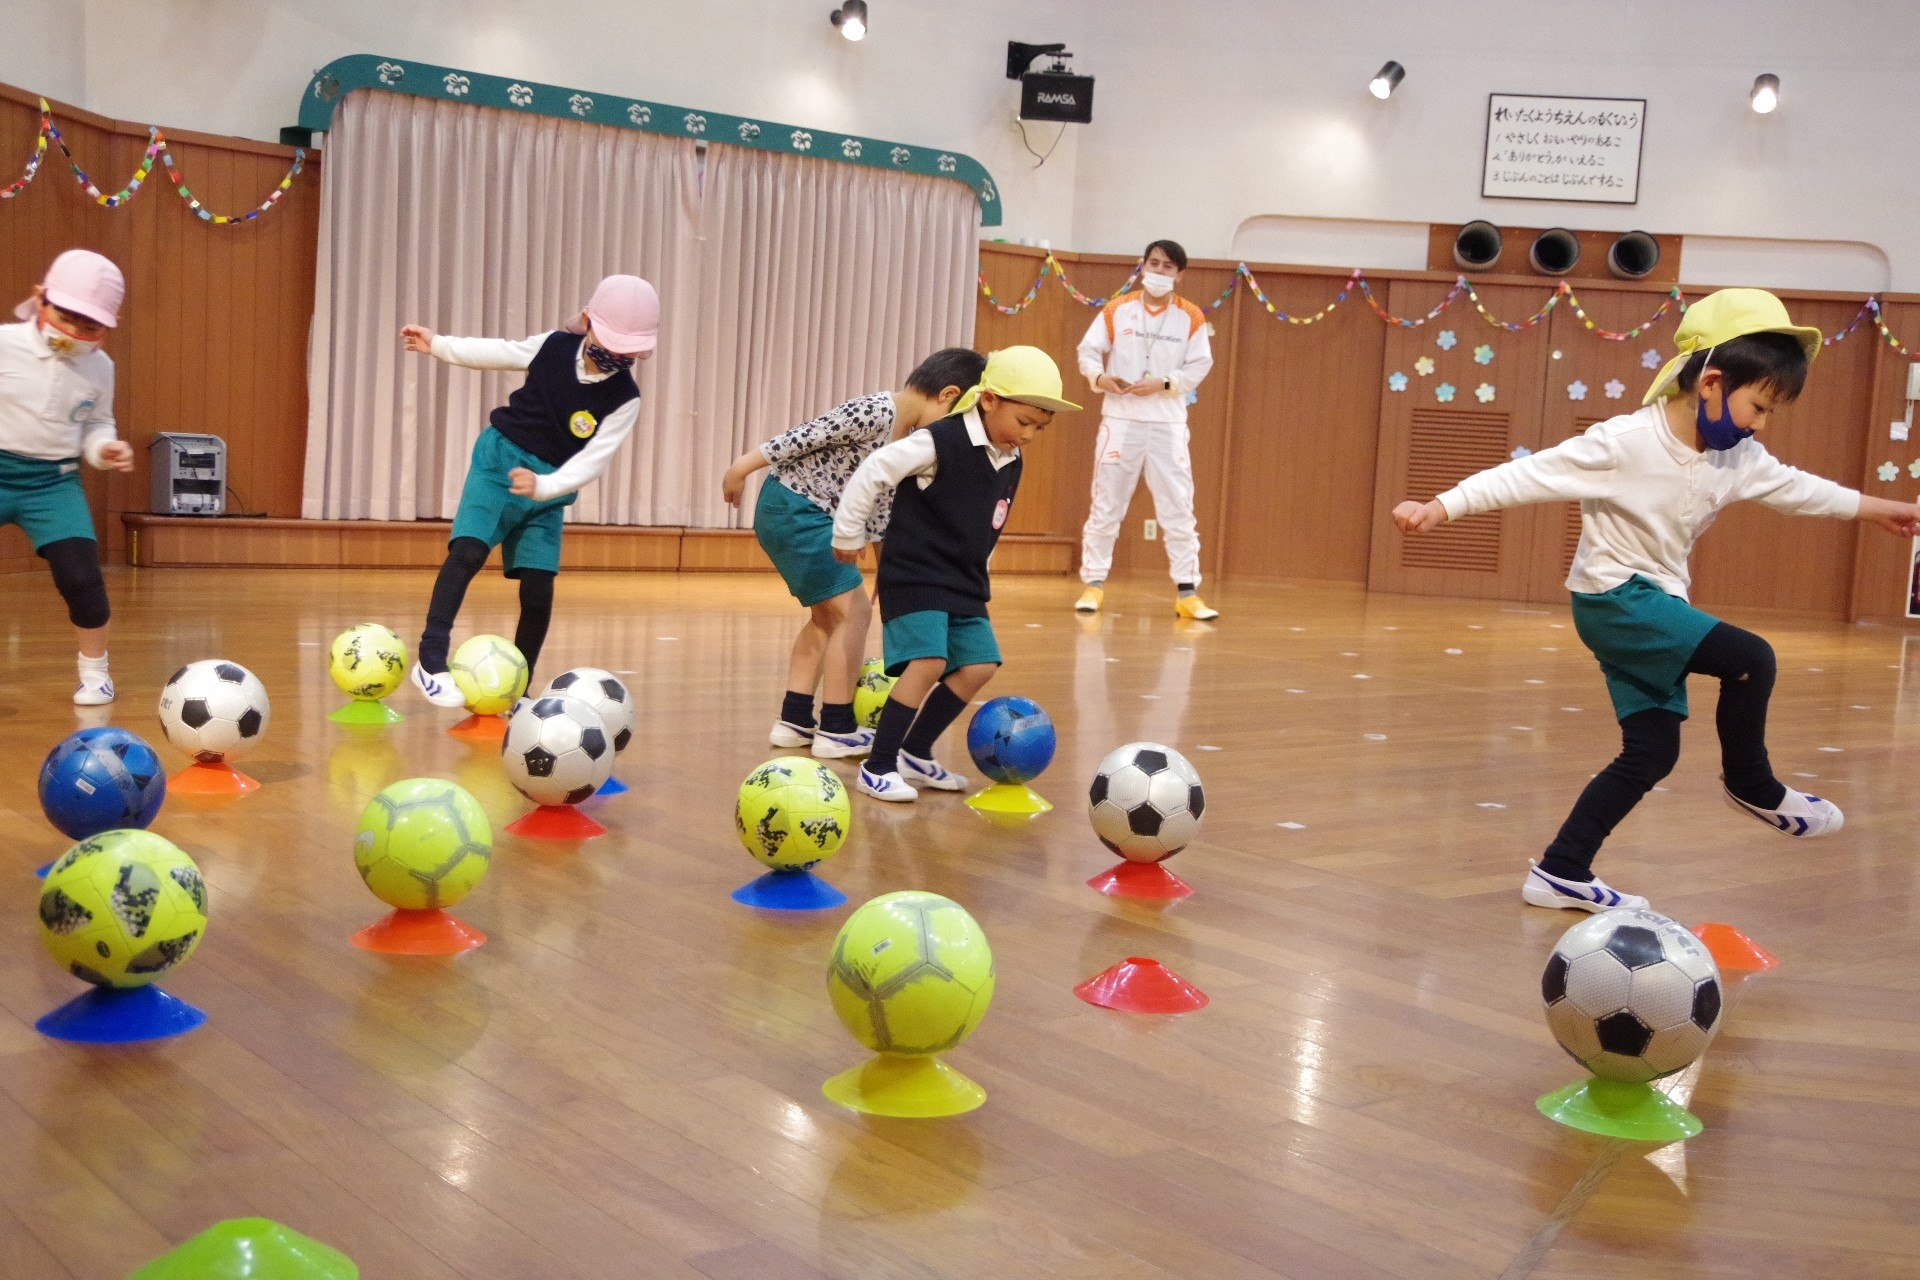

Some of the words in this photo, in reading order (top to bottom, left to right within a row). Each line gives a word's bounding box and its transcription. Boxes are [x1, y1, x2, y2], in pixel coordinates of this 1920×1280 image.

[1037, 91, 1076, 105] RAMSA
[1494, 107, 1639, 129] れいたくようちえんのもくひょう
